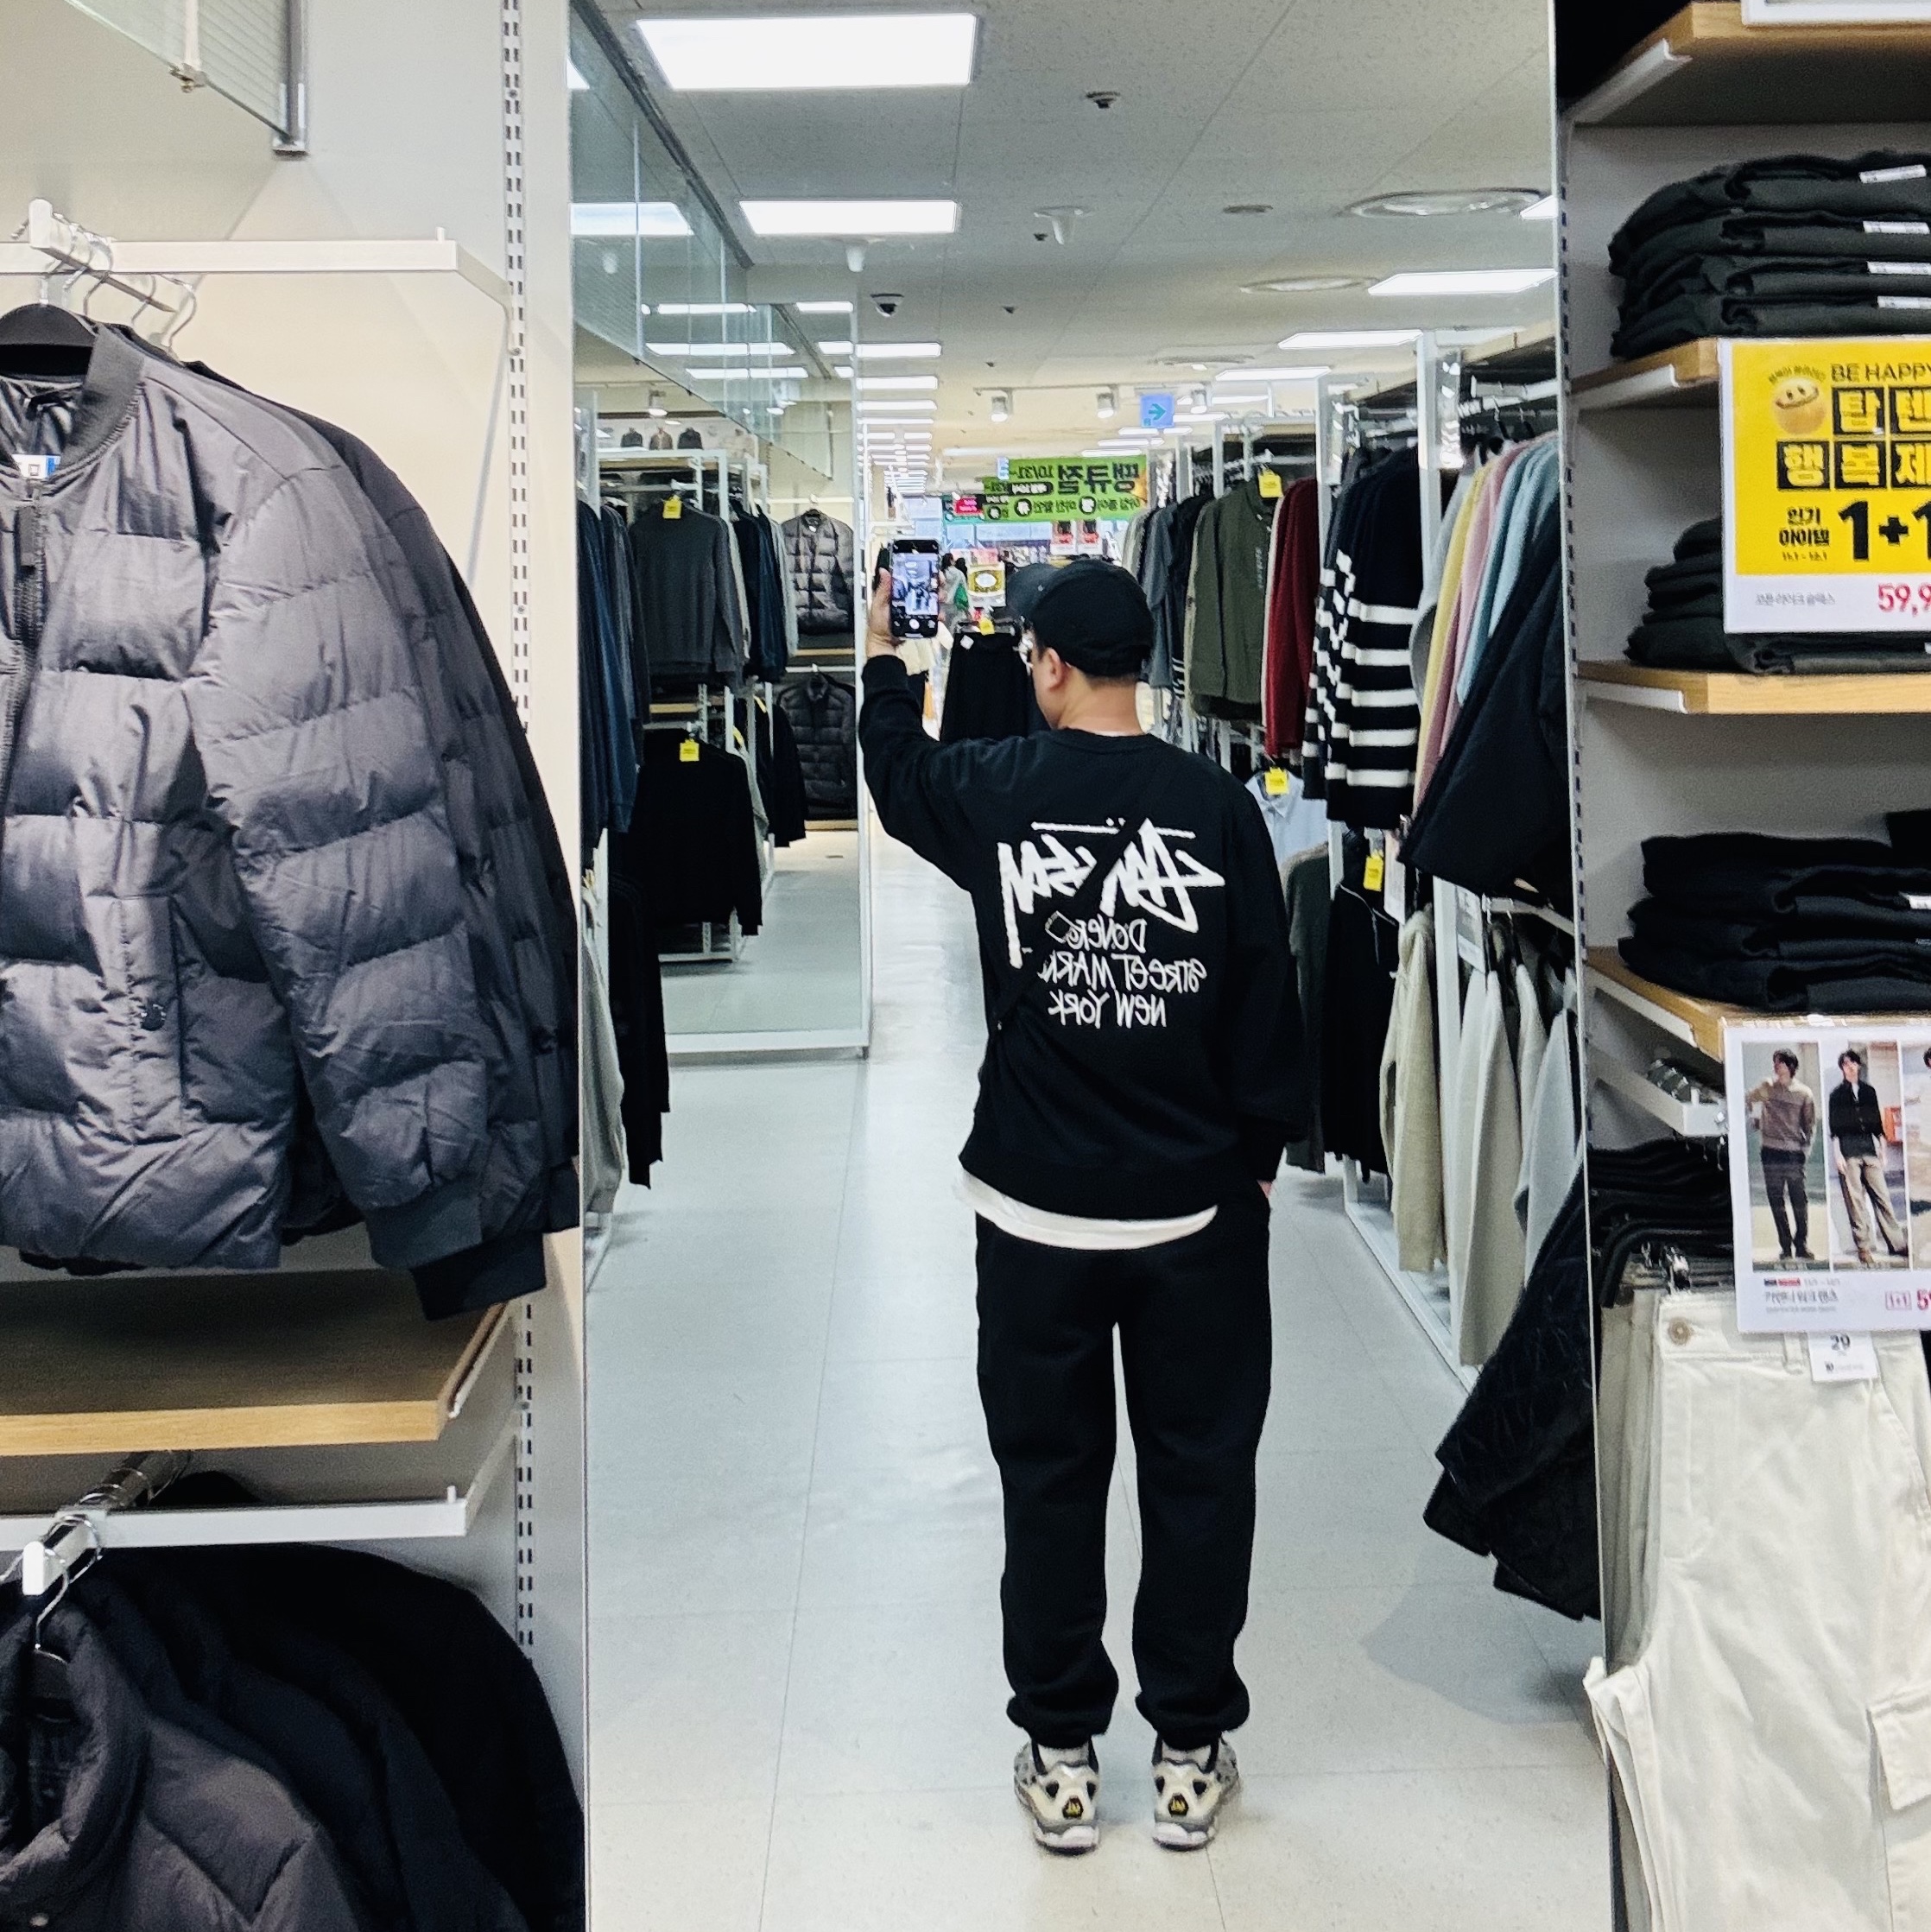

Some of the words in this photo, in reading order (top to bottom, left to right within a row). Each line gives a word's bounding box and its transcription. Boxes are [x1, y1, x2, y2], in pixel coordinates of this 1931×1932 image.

[1831, 363, 1859, 382] BE
[1787, 507, 1820, 526] 인기
[1779, 529, 1830, 547] 아이템
